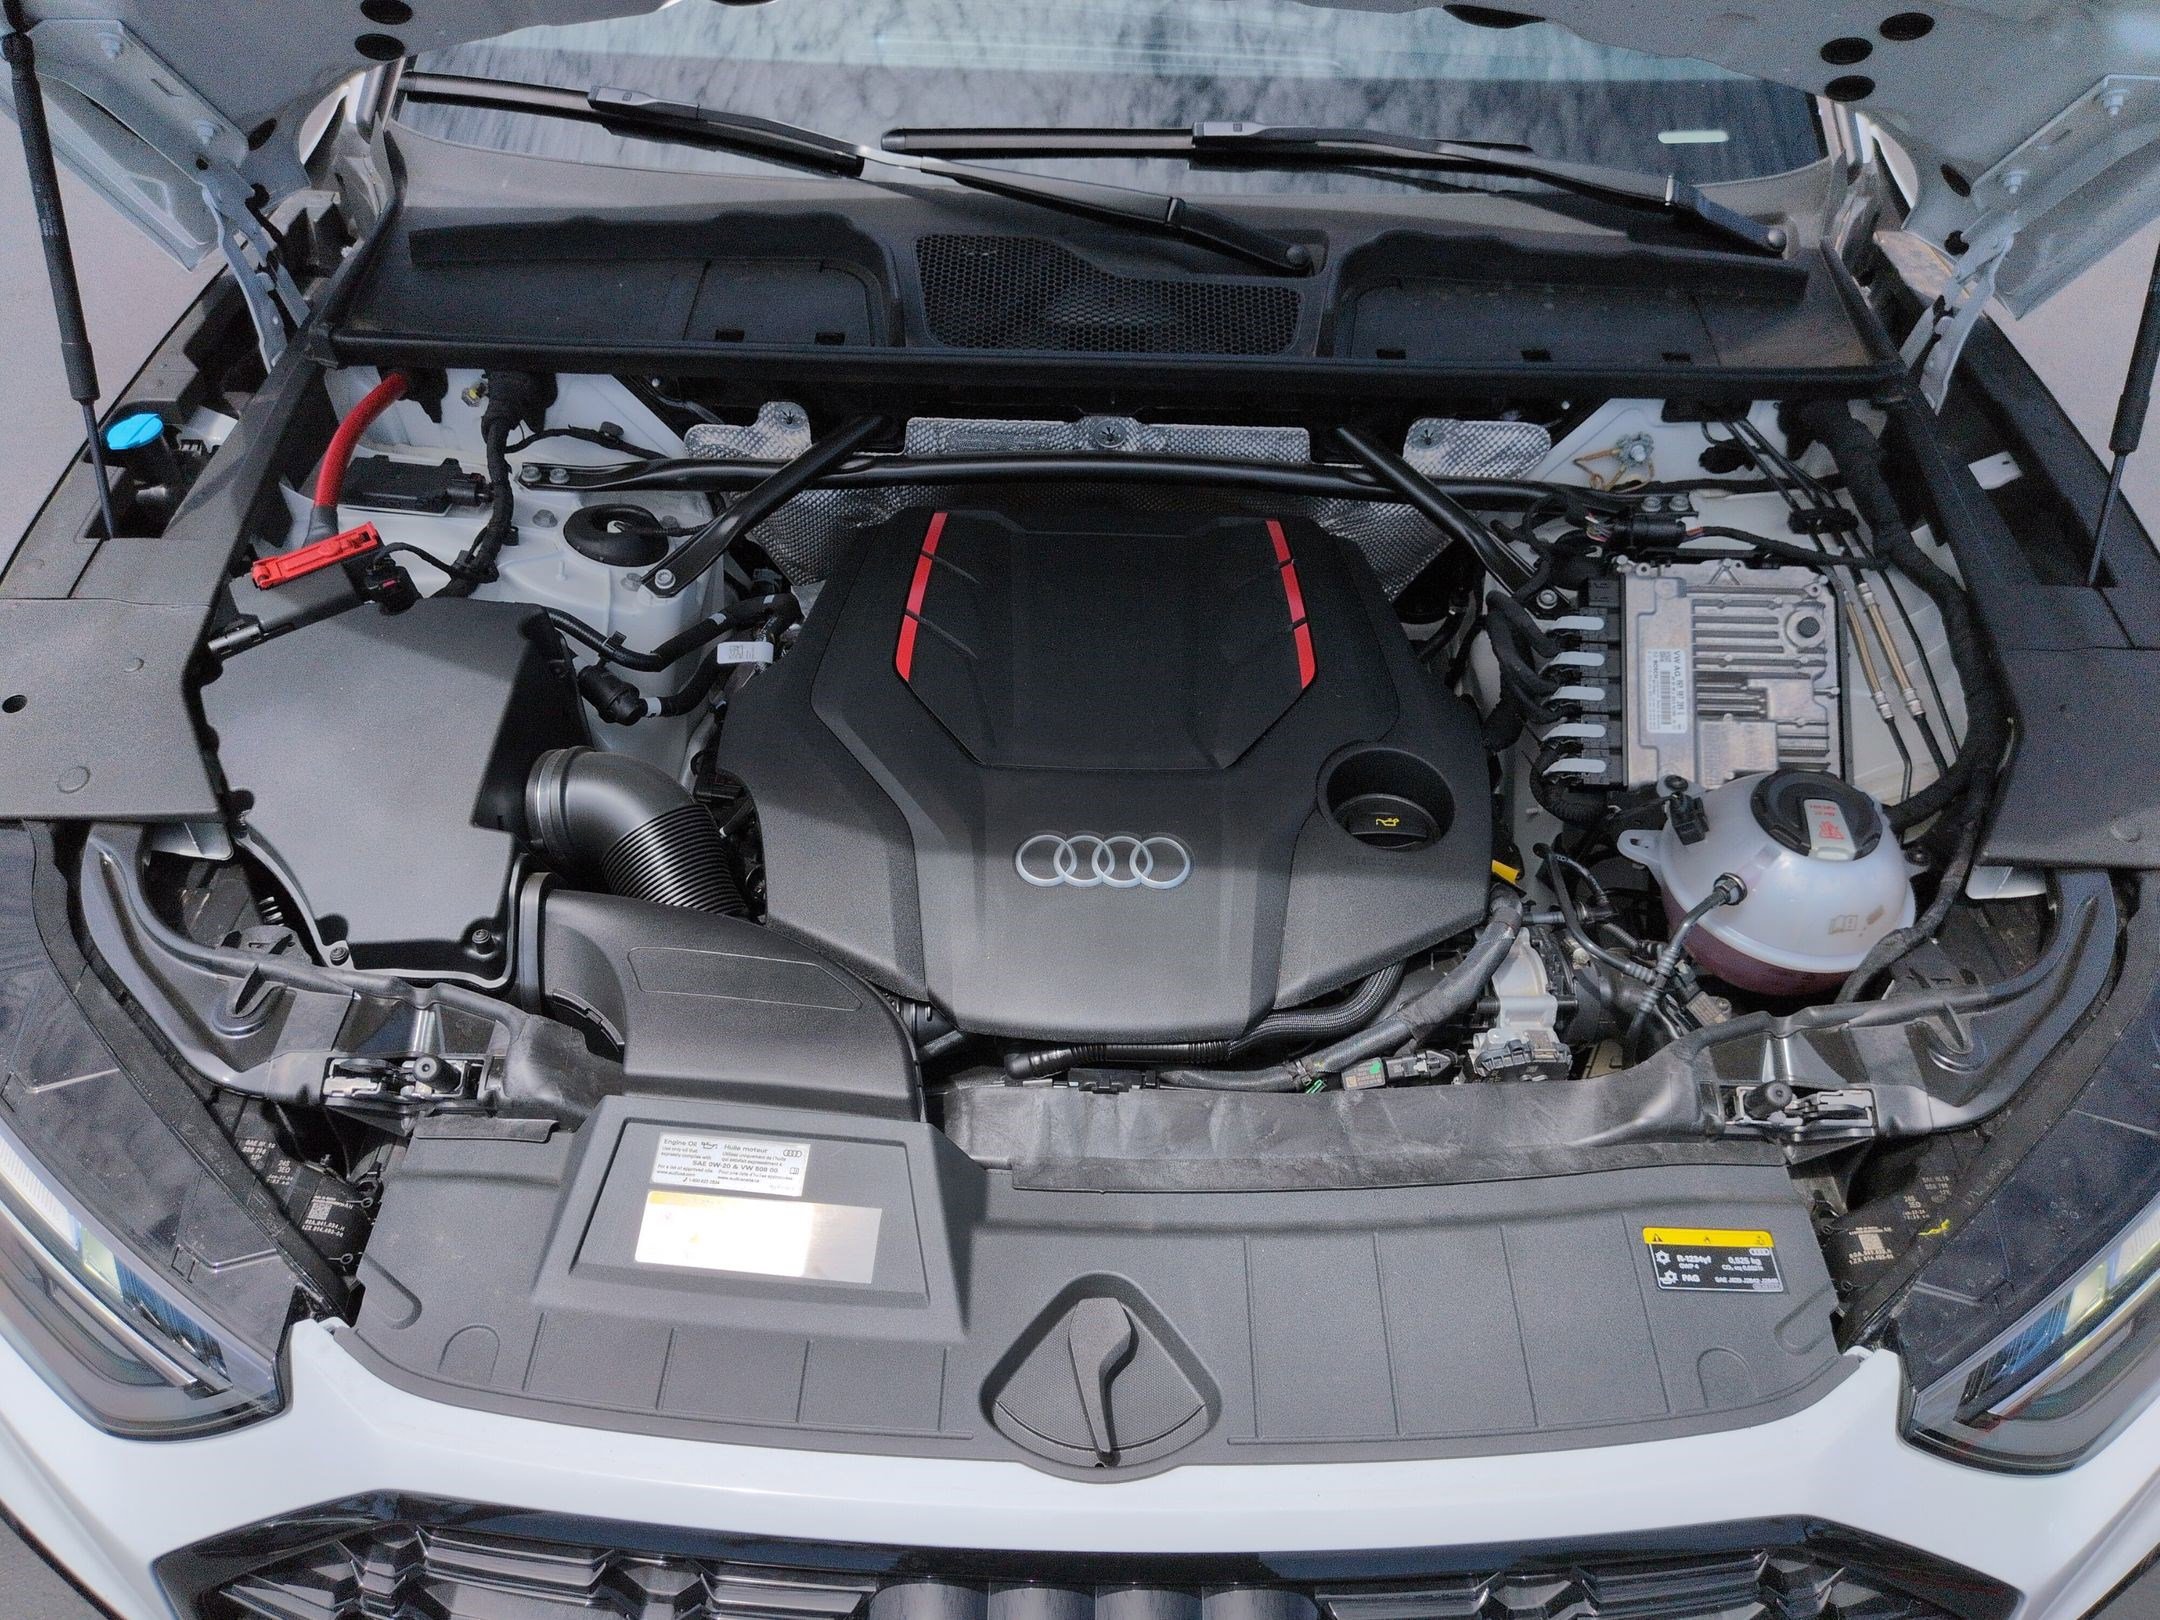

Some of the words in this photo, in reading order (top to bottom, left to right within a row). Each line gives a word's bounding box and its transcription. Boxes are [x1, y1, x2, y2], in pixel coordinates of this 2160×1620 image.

[1674, 650, 1680, 664] VW
[1674, 666, 1680, 676] AG
[664, 1138, 686, 1147] Engine
[1682, 1274, 1700, 1282] PAG
